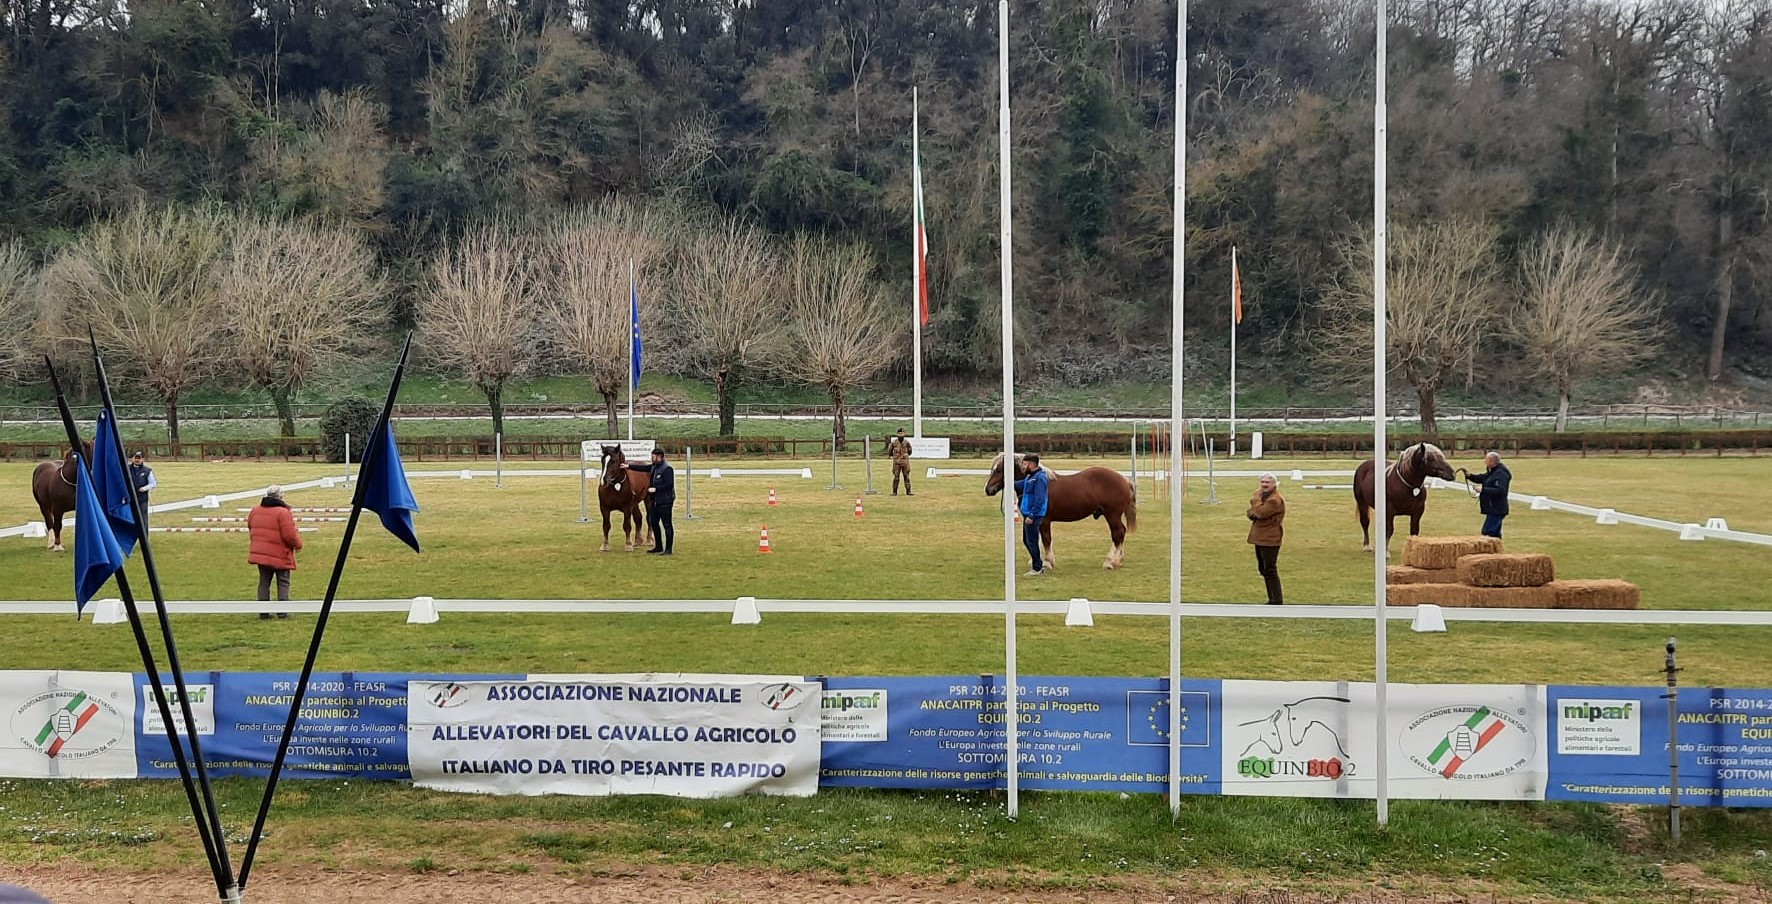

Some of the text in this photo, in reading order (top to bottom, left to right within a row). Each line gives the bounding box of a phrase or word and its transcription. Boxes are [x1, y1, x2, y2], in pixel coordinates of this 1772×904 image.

[273, 682, 290, 692] PSR
[293, 682, 344, 692] 214-2020
[354, 682, 386, 692] FEASR
[950, 686, 968, 695] PSR
[972, 686, 1026, 695] 2014-220
[1037, 687, 1070, 697] FEASR
[487, 685, 624, 701] ASSOCIAZIONE
[629, 686, 742, 703] NAZIONALE
[246, 696, 408, 708] ANACAIT partecipa al Progett
[920, 700, 1099, 713] ANACAITPR partcipa al Progetto
[1710, 699, 1731, 709] PSR
[298, 709, 360, 719] EQUINBIO.2
[1564, 703, 1632, 722] mipaaf
[1409, 708, 1452, 731] ASSOCIAZIONE
[1492, 711, 1528, 733] ALLEVATORI
[1678, 713, 1747, 724] ANACAITPR
[236, 723, 260, 731] Fondo
[361, 724, 396, 733] Sviluppo
[330, 736, 348, 744] nelle
[374, 736, 396, 744] rurali
[432, 725, 797, 744] ALLEVATORI DEL CAVALLO AGRICOLO
[909, 729, 936, 737] Fondo
[939, 729, 975, 738] Europeo
[1044, 730, 1081, 740] Sviluppo
[287, 747, 378, 757] OTTOMISURA 10.2
[939, 742, 975, 750] L'Europa
[1016, 742, 1031, 750] elle
[1057, 743, 1081, 751] rurali
[1664, 743, 1772, 754] Fndo Europeo Agrico
[958, 754, 1062, 764] SOTTOMIURA 10.2
[1697, 757, 1738, 767] L'Europa
[232, 761, 253, 769] delle
[375, 763, 409, 772] salvagu
[442, 760, 787, 779] ITALIANO DA TIRO PESANTE RAPIDO
[1240, 759, 1356, 778] EQUINBIO.2
[1410, 755, 1437, 774] CAVALLO
[1474, 770, 1504, 779] ITALIANO
[1505, 766, 1514, 774] DA
[906, 769, 924, 778] delle
[930, 769, 961, 779] risorse
[1016, 771, 1046, 779] nimali
[1057, 771, 1117, 781] salvaguardia
[1121, 772, 1144, 782] delle
[1659, 786, 1683, 795] dee
[1687, 786, 1720, 796] risorse
